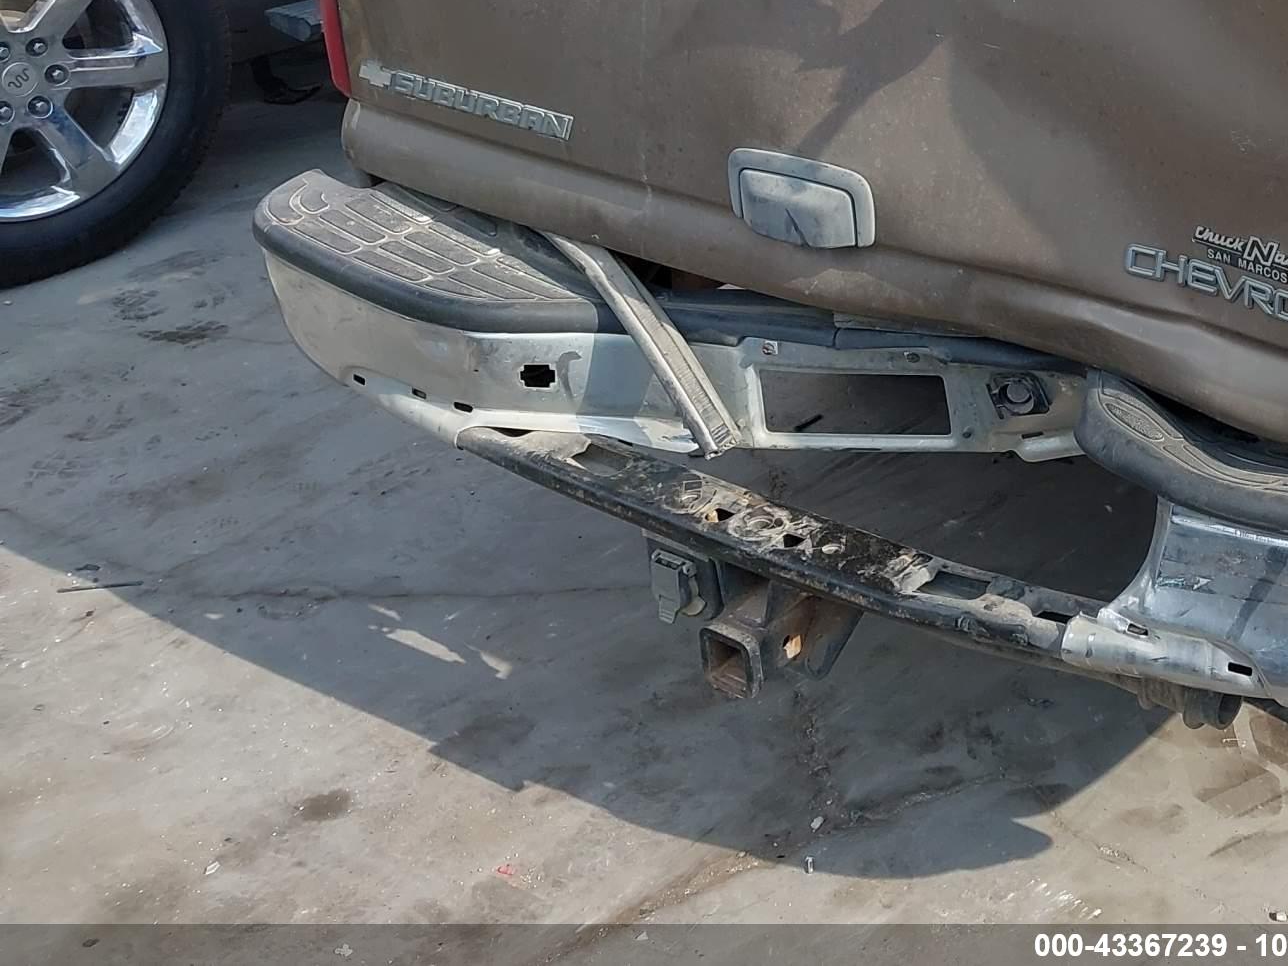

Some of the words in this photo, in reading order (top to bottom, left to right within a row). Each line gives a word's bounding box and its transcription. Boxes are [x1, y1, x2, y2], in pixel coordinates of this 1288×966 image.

[391, 69, 575, 141] SUBURBAN
[1194, 225, 1245, 252] Chuck
[1207, 247, 1231, 264] SAN
[1237, 258, 1288, 284] MARCOS
